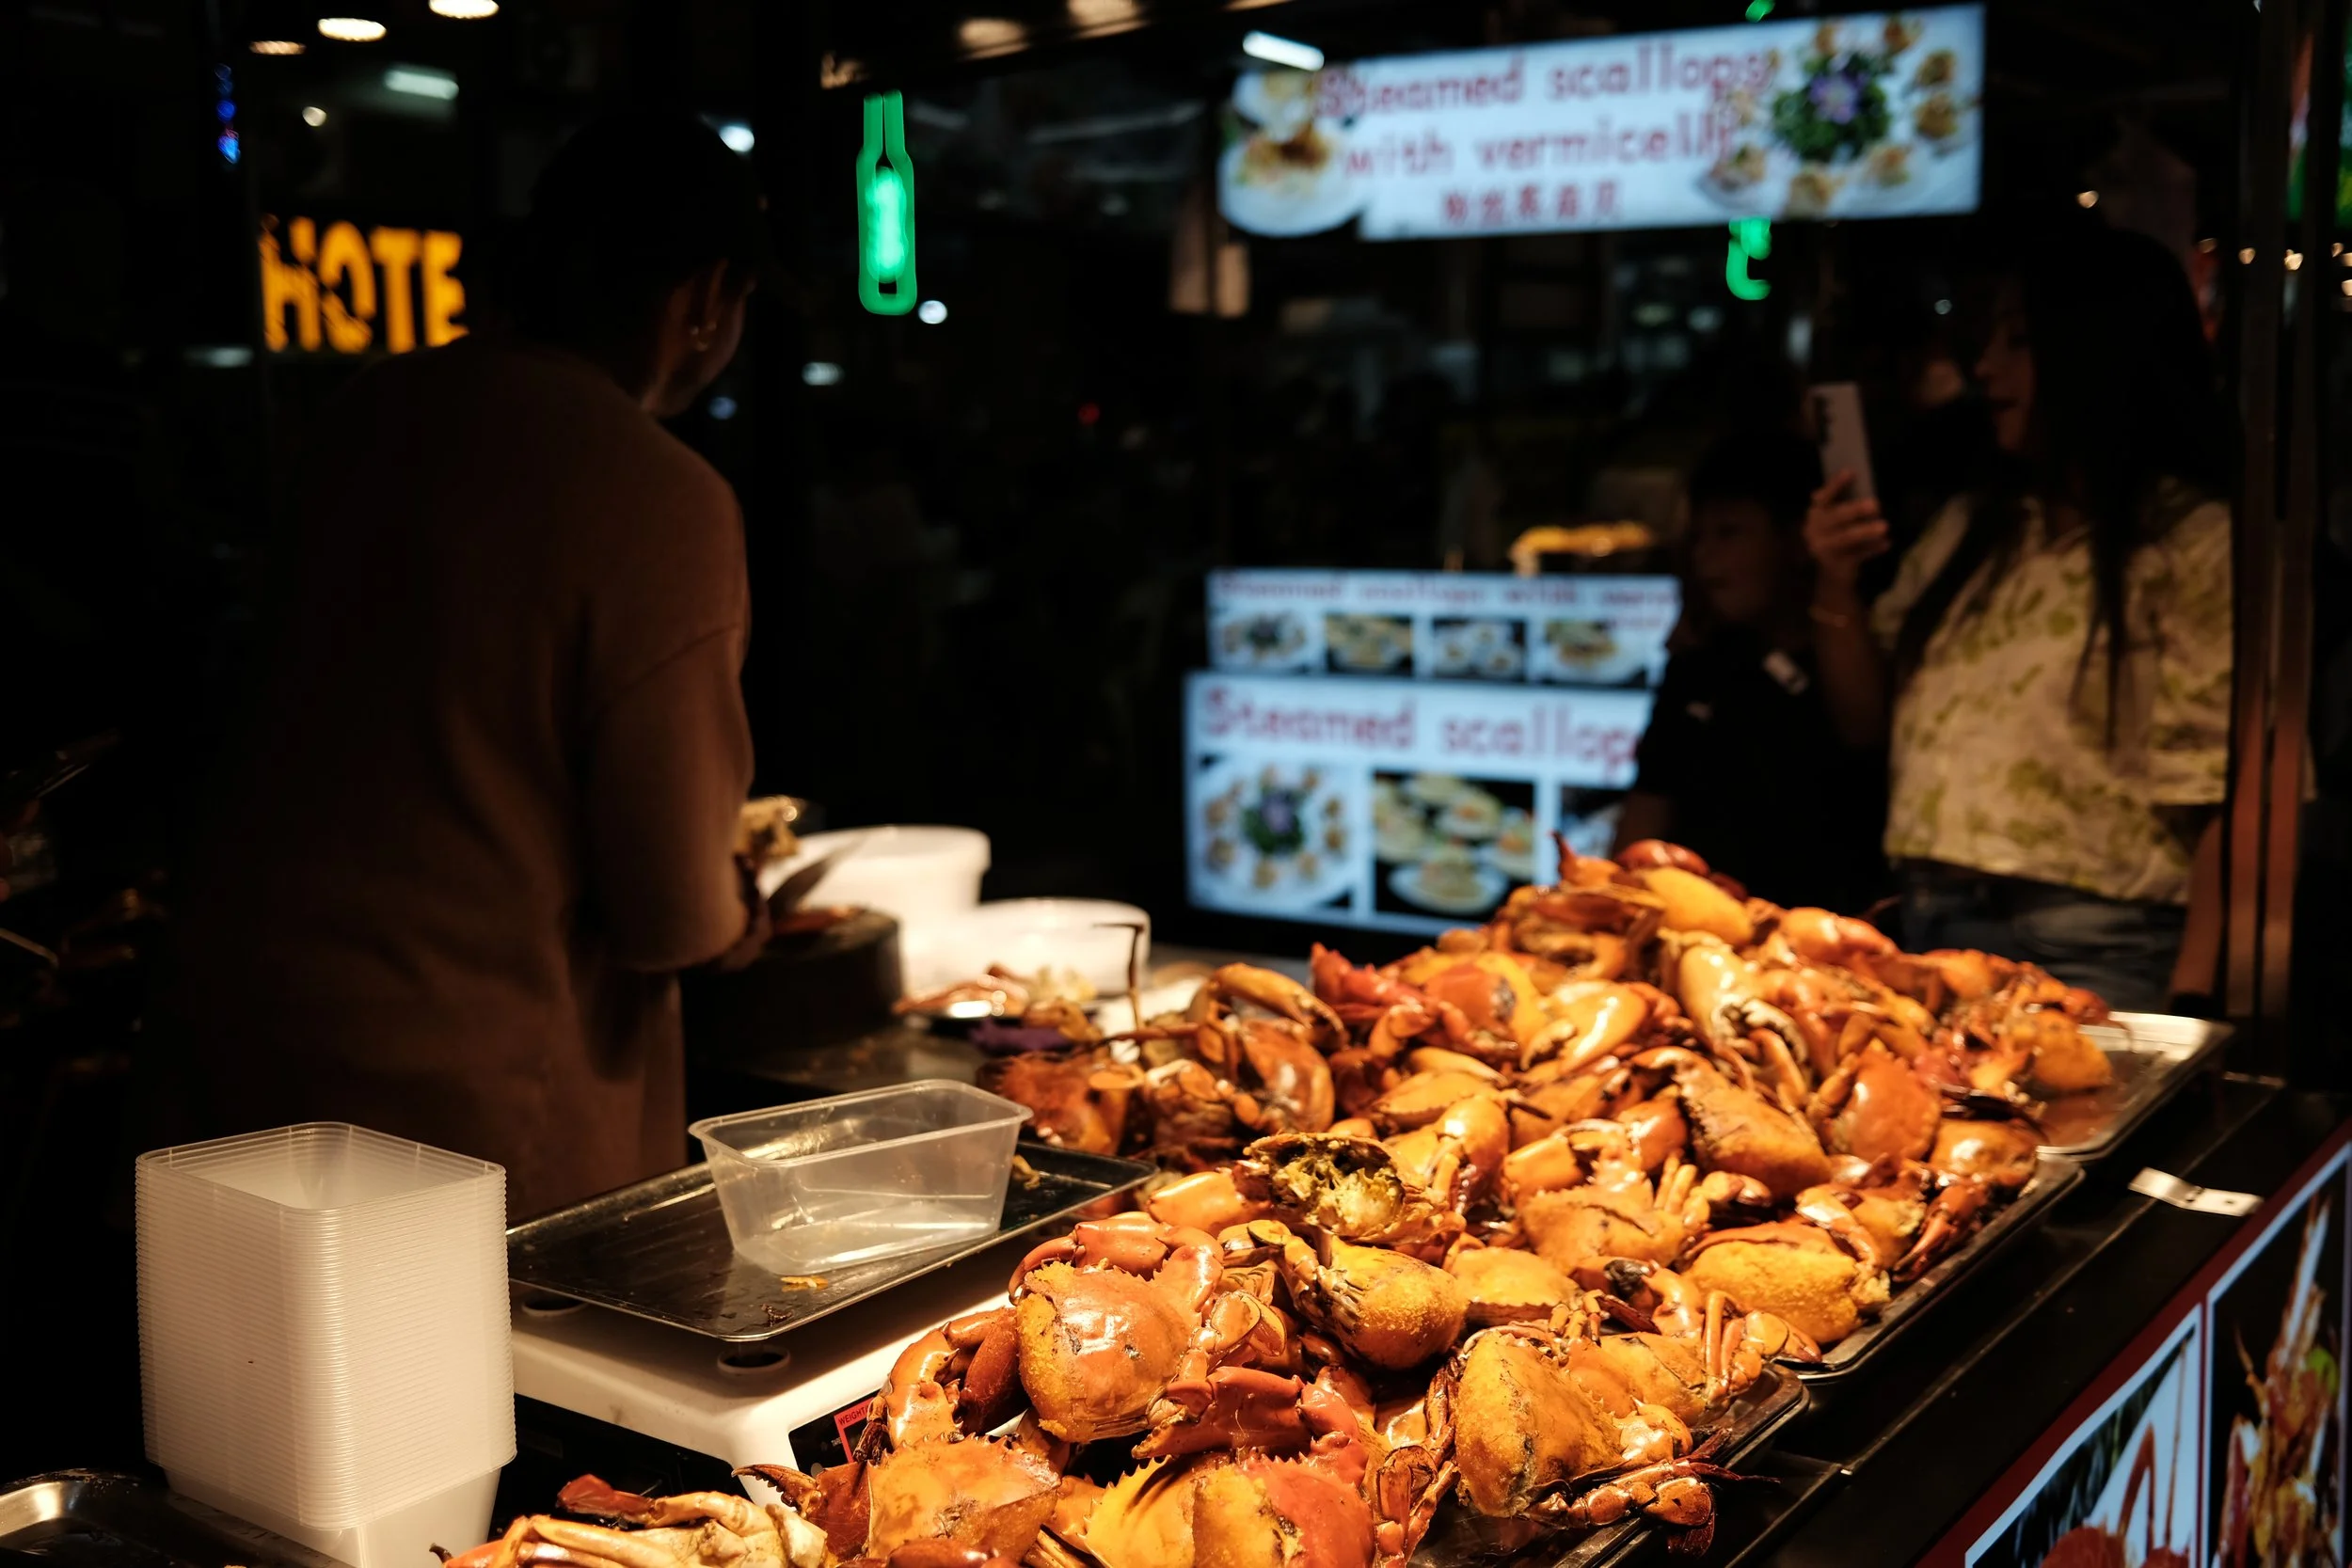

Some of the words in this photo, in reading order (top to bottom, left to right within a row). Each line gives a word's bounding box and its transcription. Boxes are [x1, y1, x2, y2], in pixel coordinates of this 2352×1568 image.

[1315, 47, 1526, 118] Steamed
[1548, 40, 1771, 105] scallops
[1343, 127, 1455, 179] with
[258, 214, 469, 354] HOTE
[1205, 685, 1418, 751] Steamed
[1440, 701, 1638, 788] scallop
